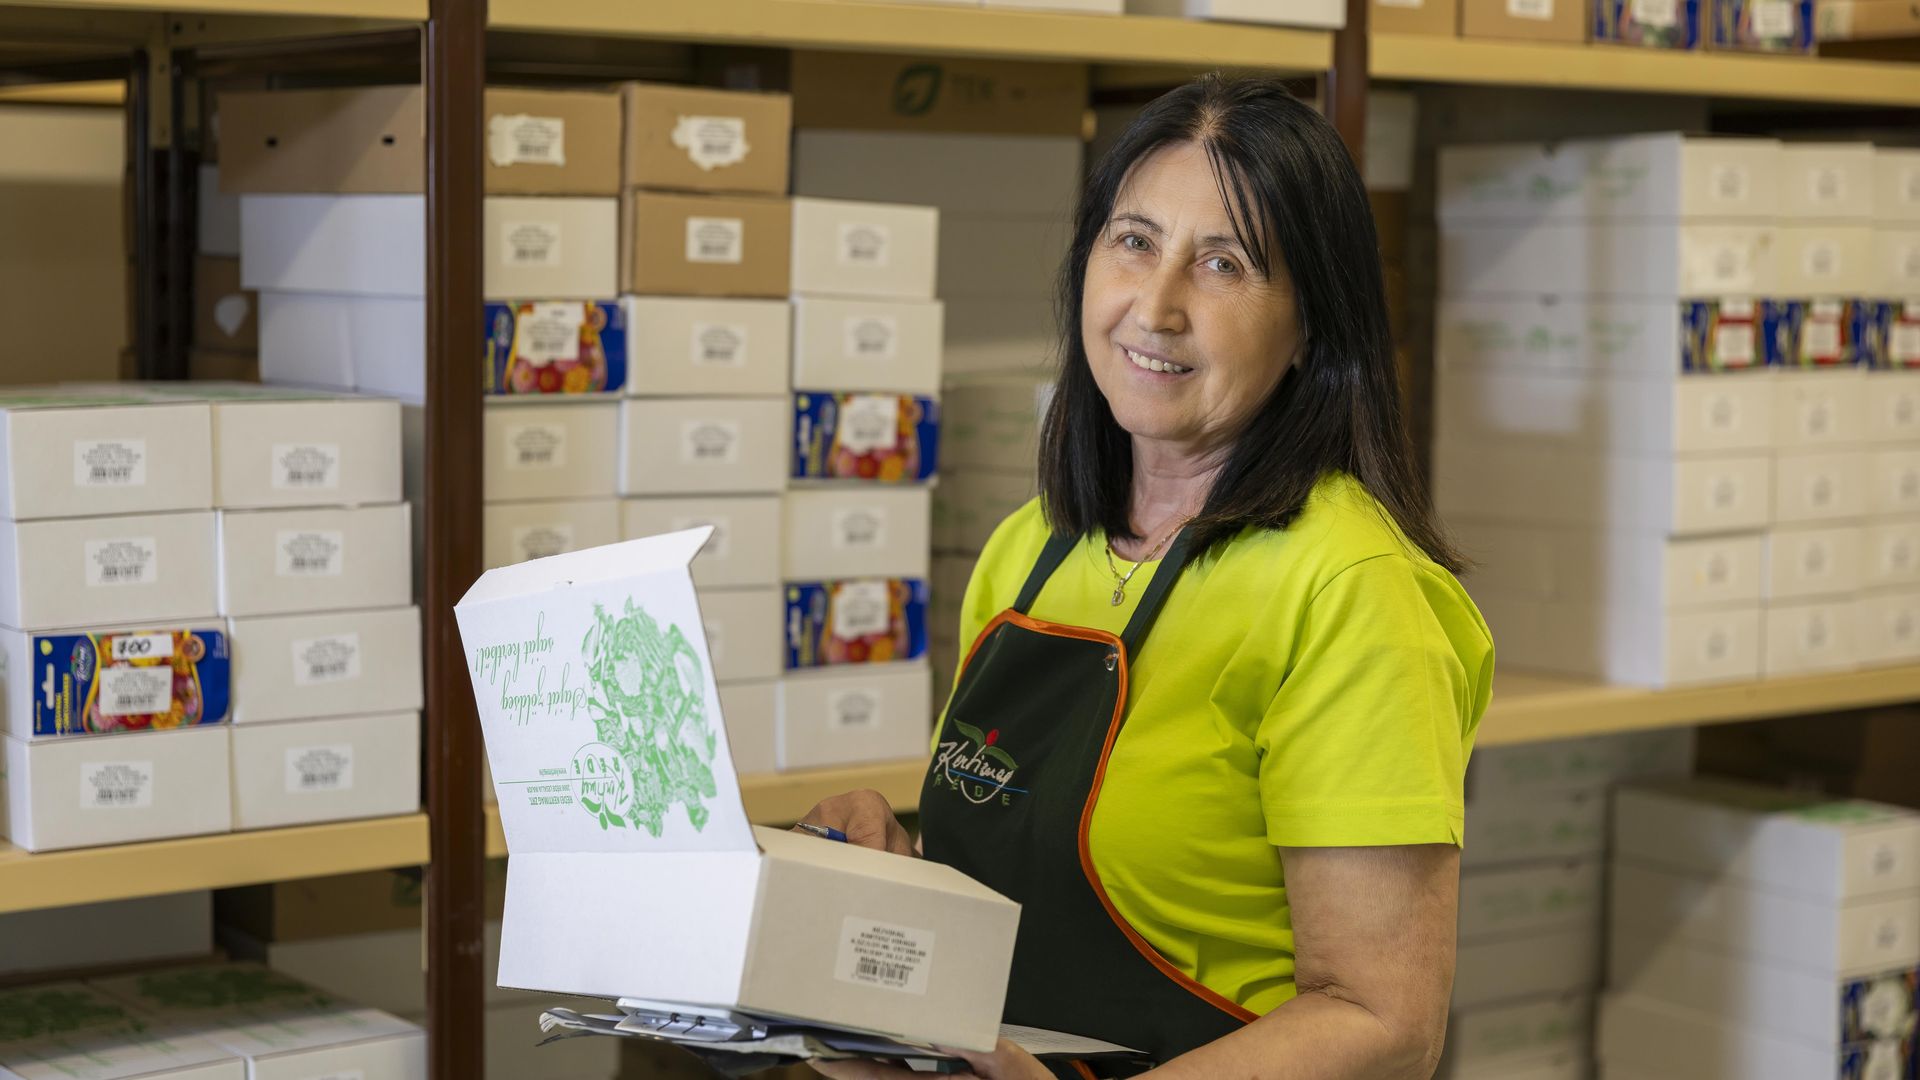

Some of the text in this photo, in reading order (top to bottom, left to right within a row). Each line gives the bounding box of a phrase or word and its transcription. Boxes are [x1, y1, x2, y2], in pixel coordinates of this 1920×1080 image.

[474, 611, 554, 686] saját kertből!
[500, 662, 587, 726] Saját zöldség
